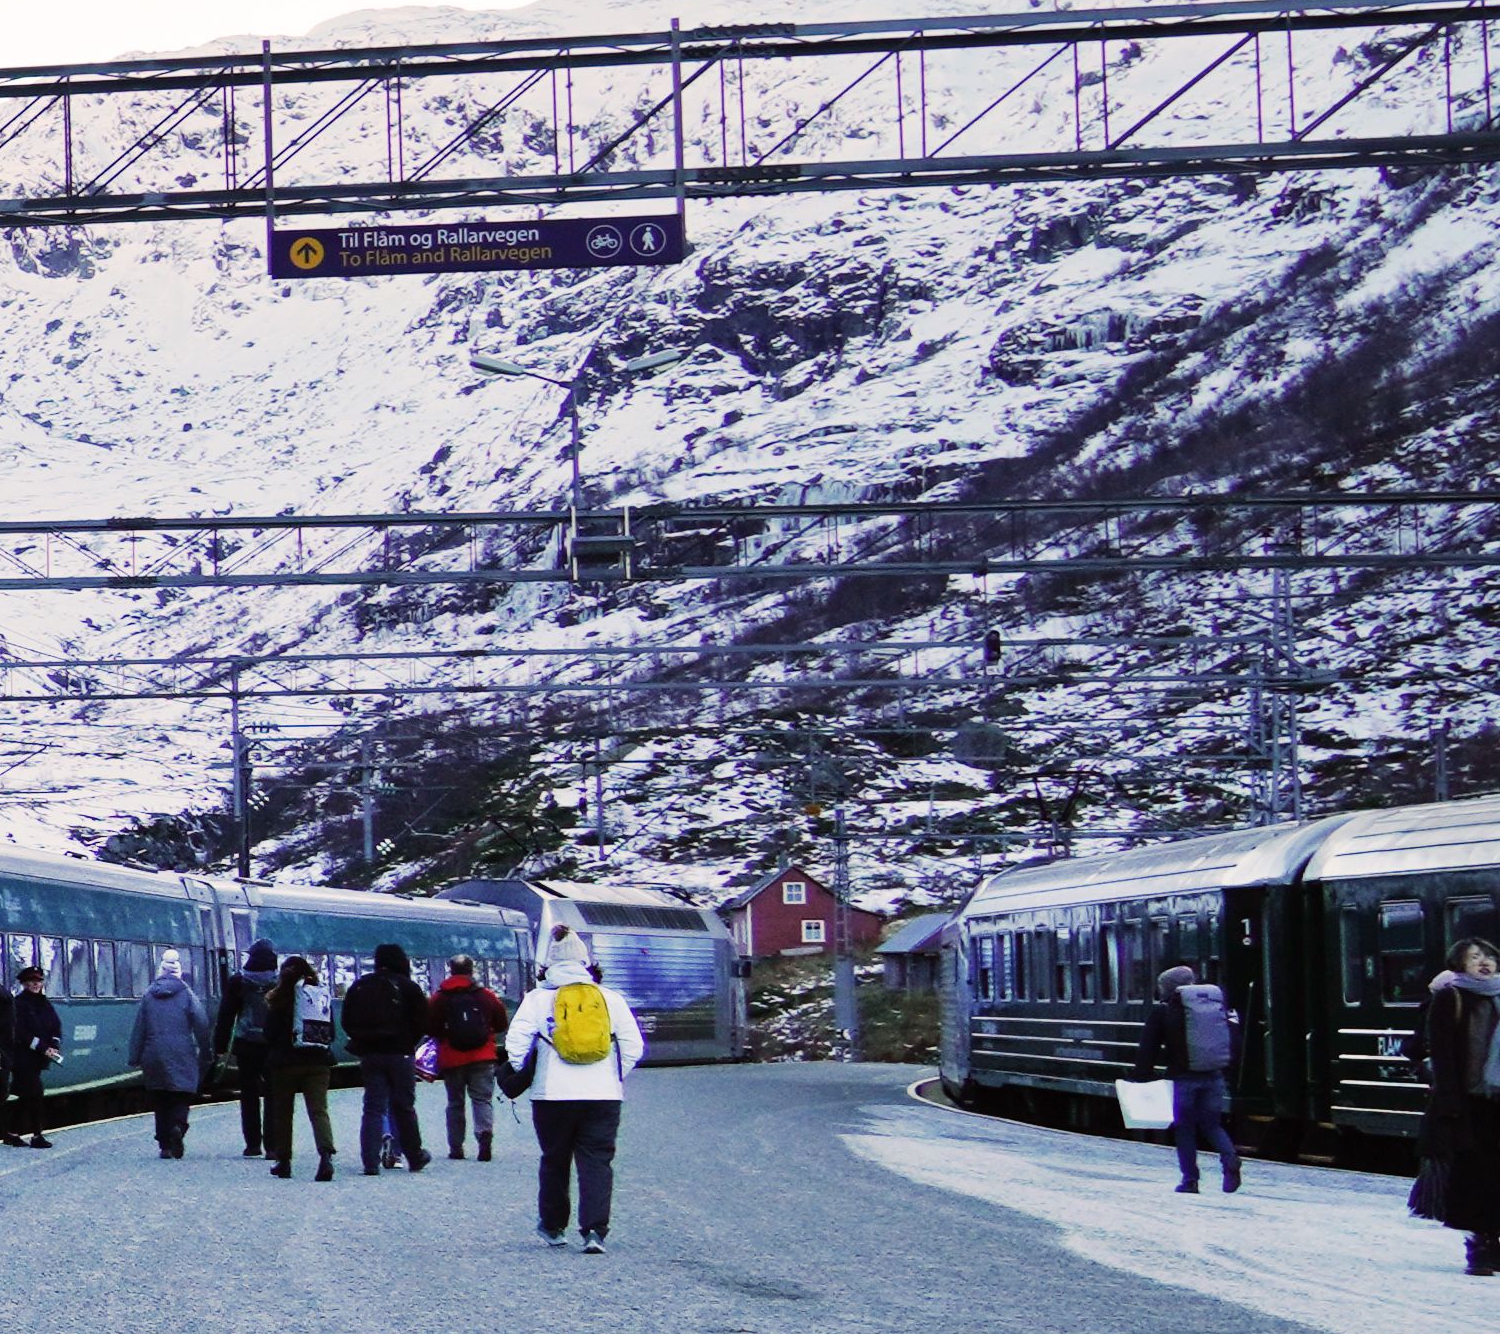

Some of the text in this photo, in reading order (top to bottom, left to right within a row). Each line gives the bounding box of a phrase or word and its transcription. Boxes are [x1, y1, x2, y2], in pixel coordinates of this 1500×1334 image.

[339, 228, 539, 249] Til Flåm og Rallarvegen
[339, 246, 552, 267] To Flåm and Rallarvegen
[1240, 918, 1251, 935] 1
